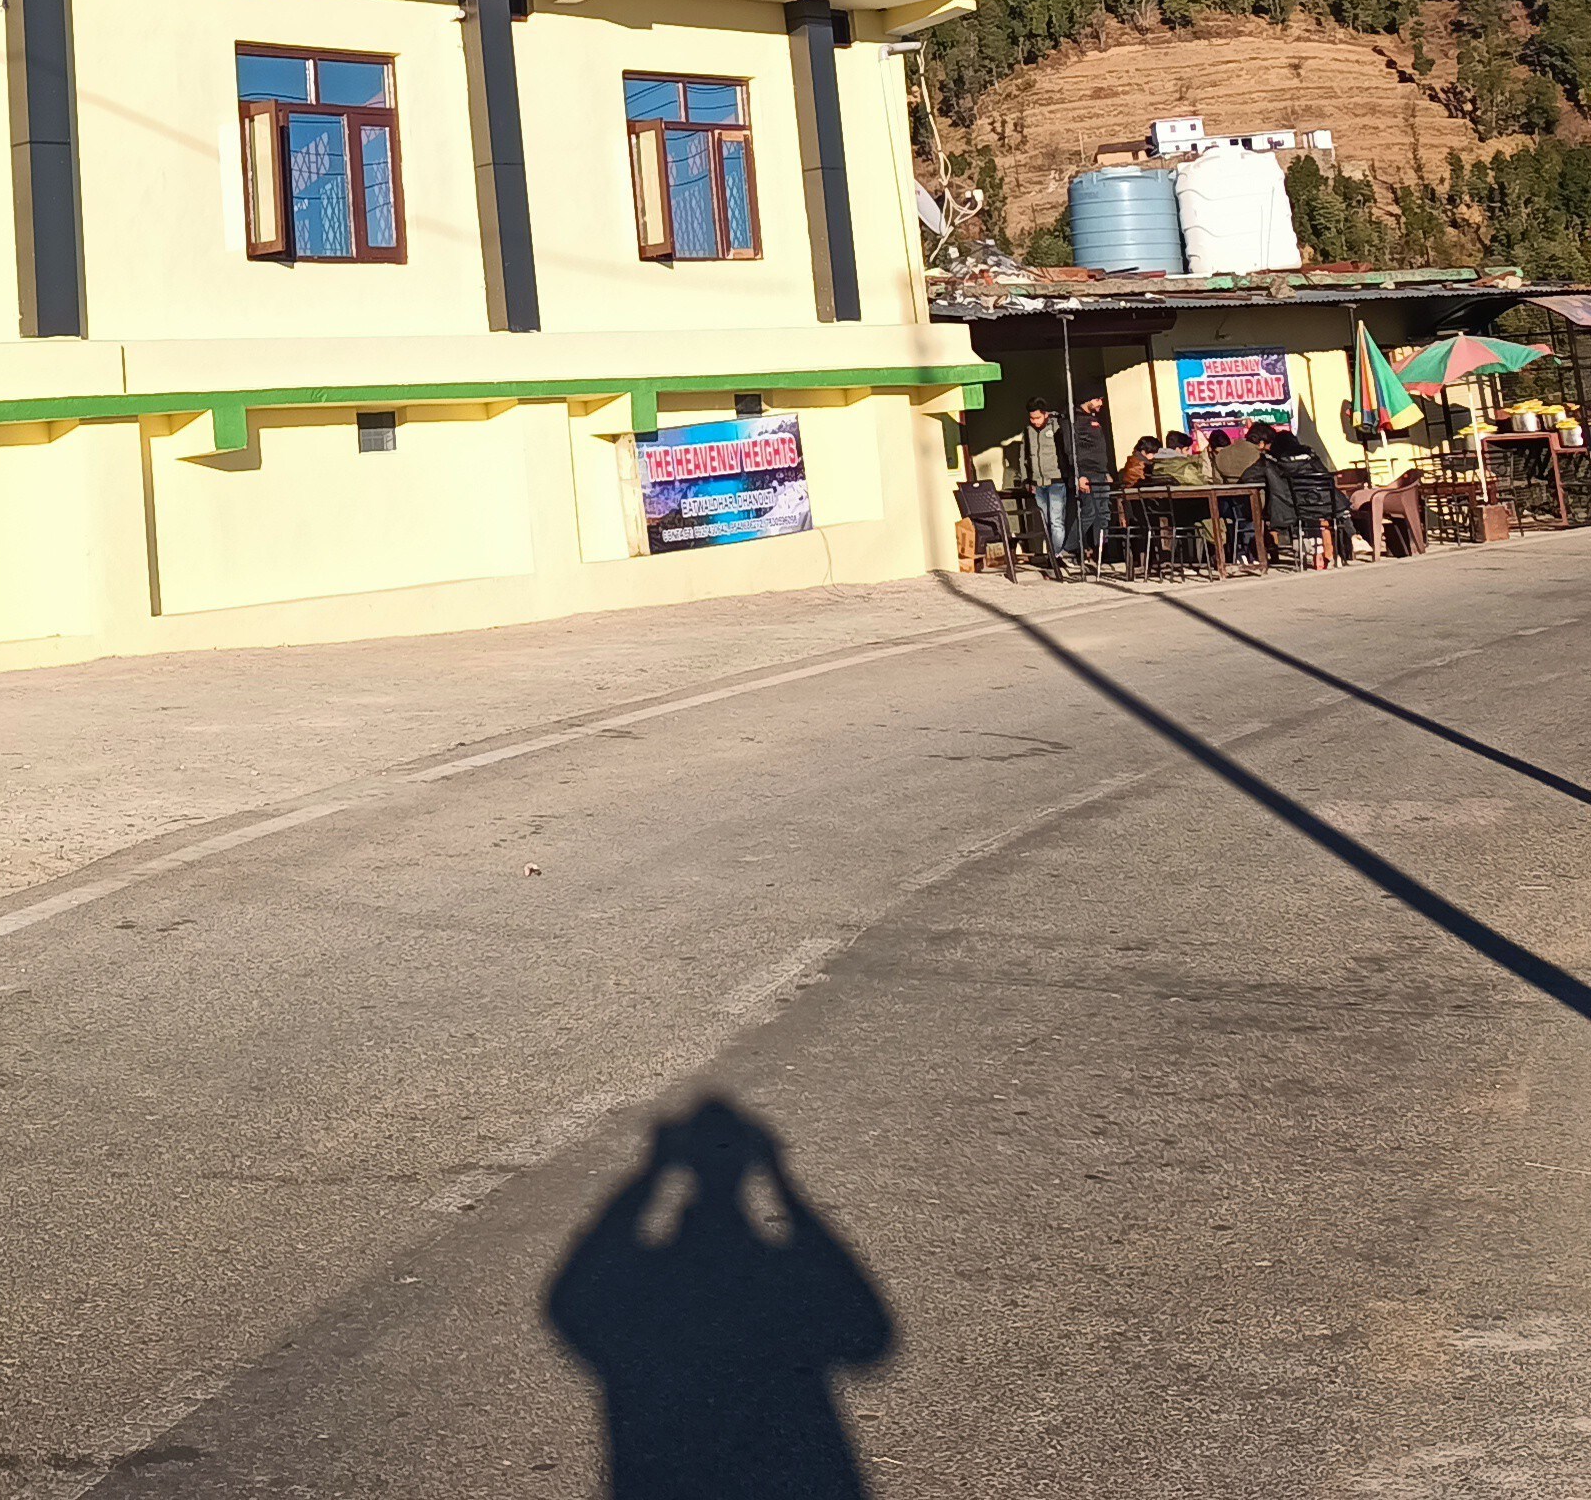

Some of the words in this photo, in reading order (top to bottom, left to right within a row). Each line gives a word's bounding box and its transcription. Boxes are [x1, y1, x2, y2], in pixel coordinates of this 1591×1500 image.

[1205, 358, 1261, 374] HEAVENLY
[1186, 376, 1283, 402] RESTAURANT
[646, 450, 672, 480] THE
[674, 443, 741, 477] HEAVENLY
[742, 436, 798, 471] HEIGHTS
